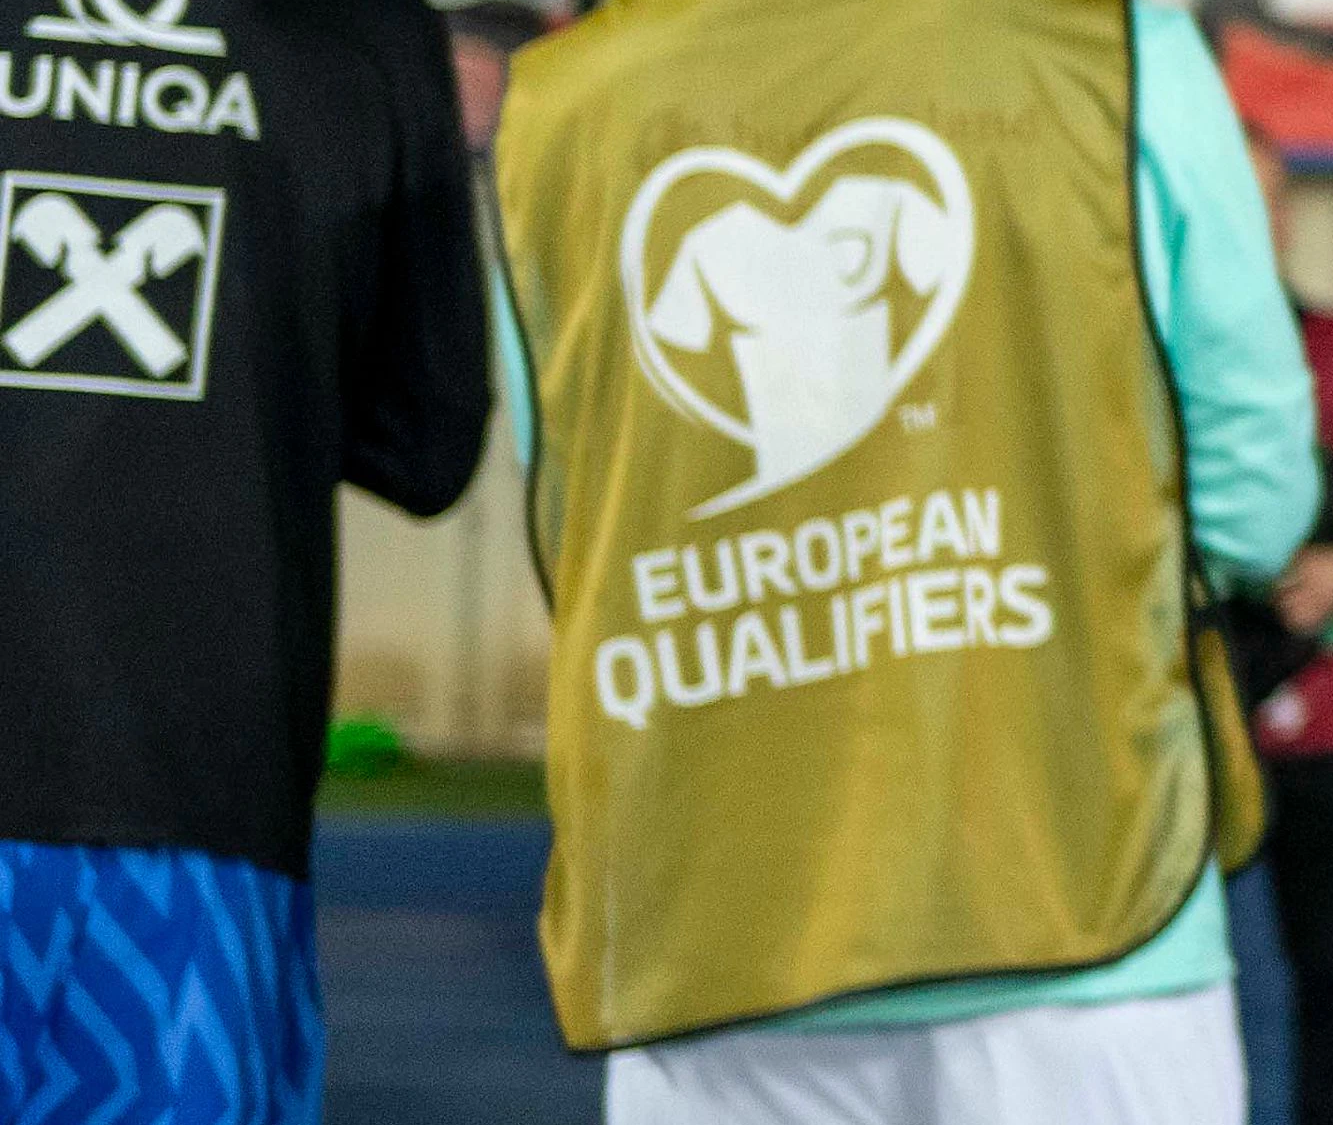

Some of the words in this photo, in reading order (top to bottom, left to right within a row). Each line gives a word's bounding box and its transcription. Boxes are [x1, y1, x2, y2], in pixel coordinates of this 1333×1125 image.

[0, 49, 262, 143] UNIQA
[901, 404, 936, 433] TM
[632, 487, 1003, 623] EUROPEAN
[594, 562, 1055, 731] QUALIFIERS
